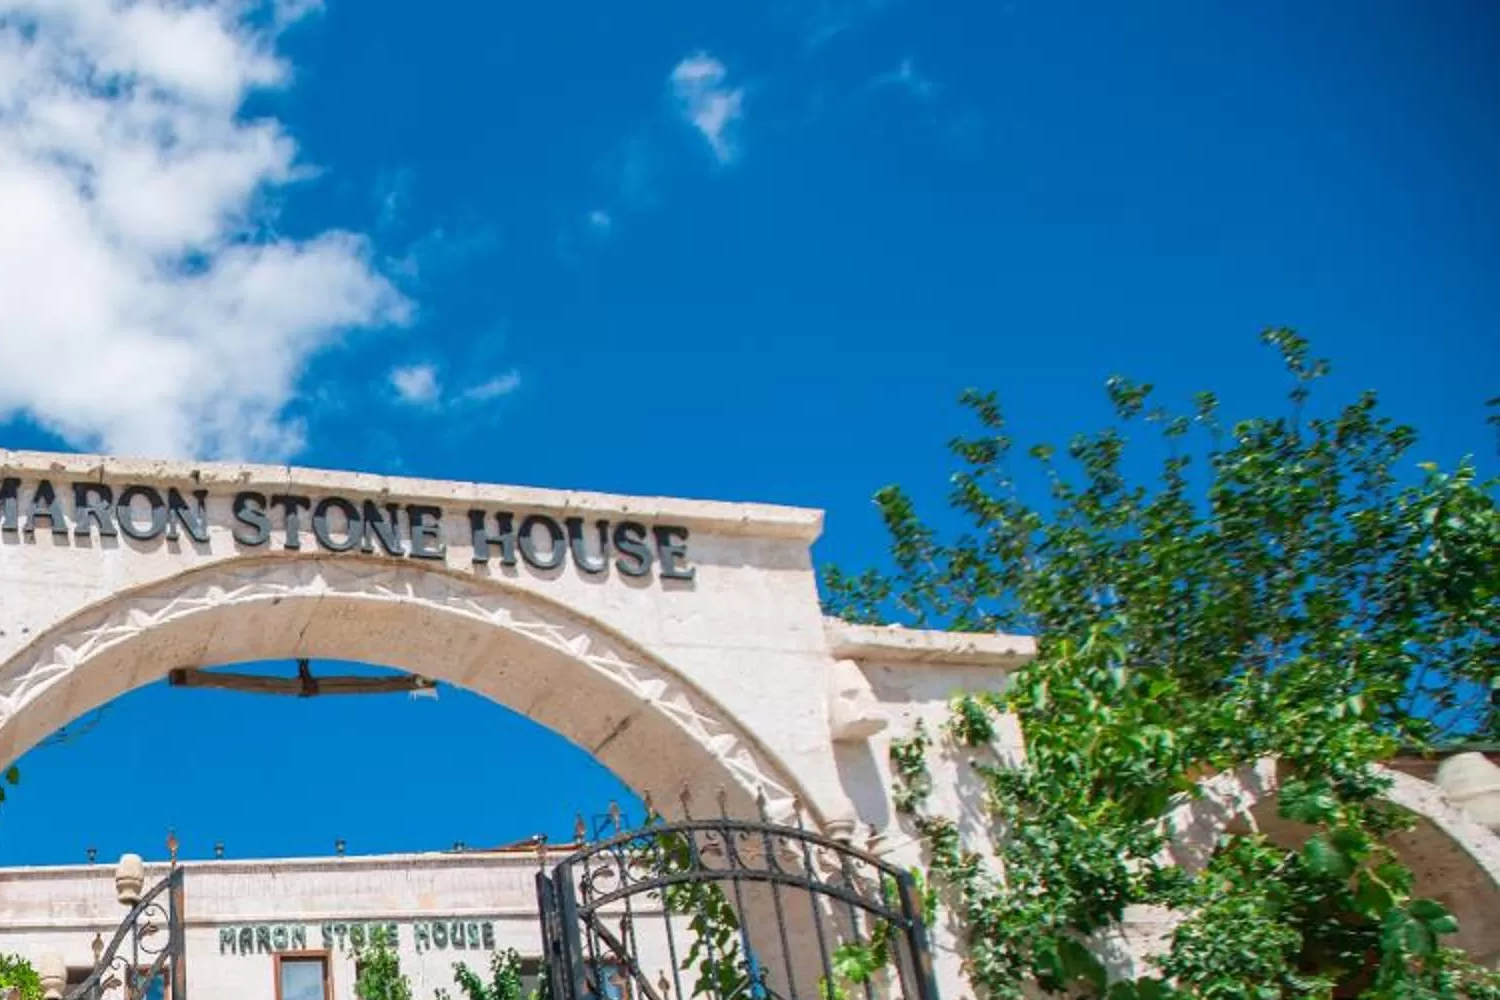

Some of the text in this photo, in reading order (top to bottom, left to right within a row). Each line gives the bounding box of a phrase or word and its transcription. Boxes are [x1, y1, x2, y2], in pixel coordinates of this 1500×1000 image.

[232, 491, 453, 562] STONE
[471, 508, 697, 581] HOUSE
[219, 926, 307, 956] MARON
[414, 921, 495, 952] HOUSE
